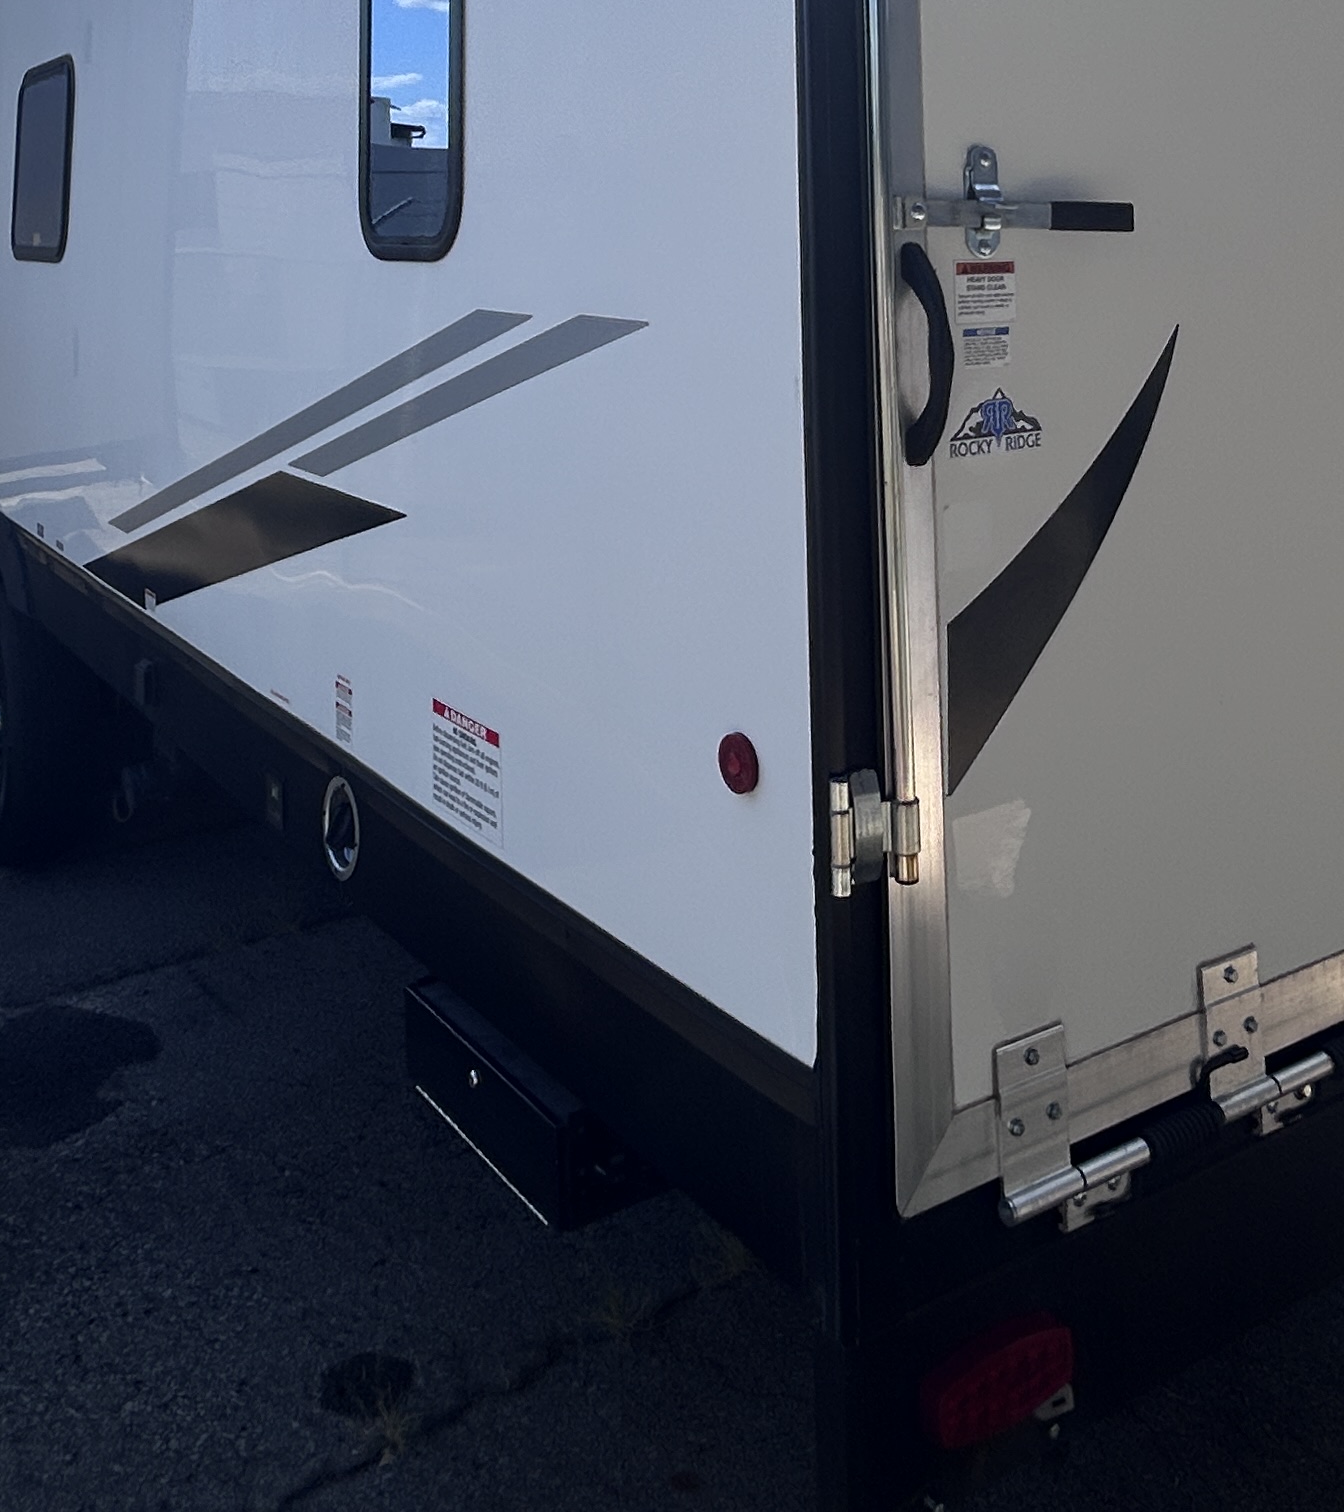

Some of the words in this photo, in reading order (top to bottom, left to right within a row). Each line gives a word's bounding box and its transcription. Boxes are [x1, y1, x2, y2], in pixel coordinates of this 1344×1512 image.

[949, 439, 994, 458] ROCKY
[1005, 432, 1042, 451] RIDGE
[450, 710, 487, 741] DANGER
